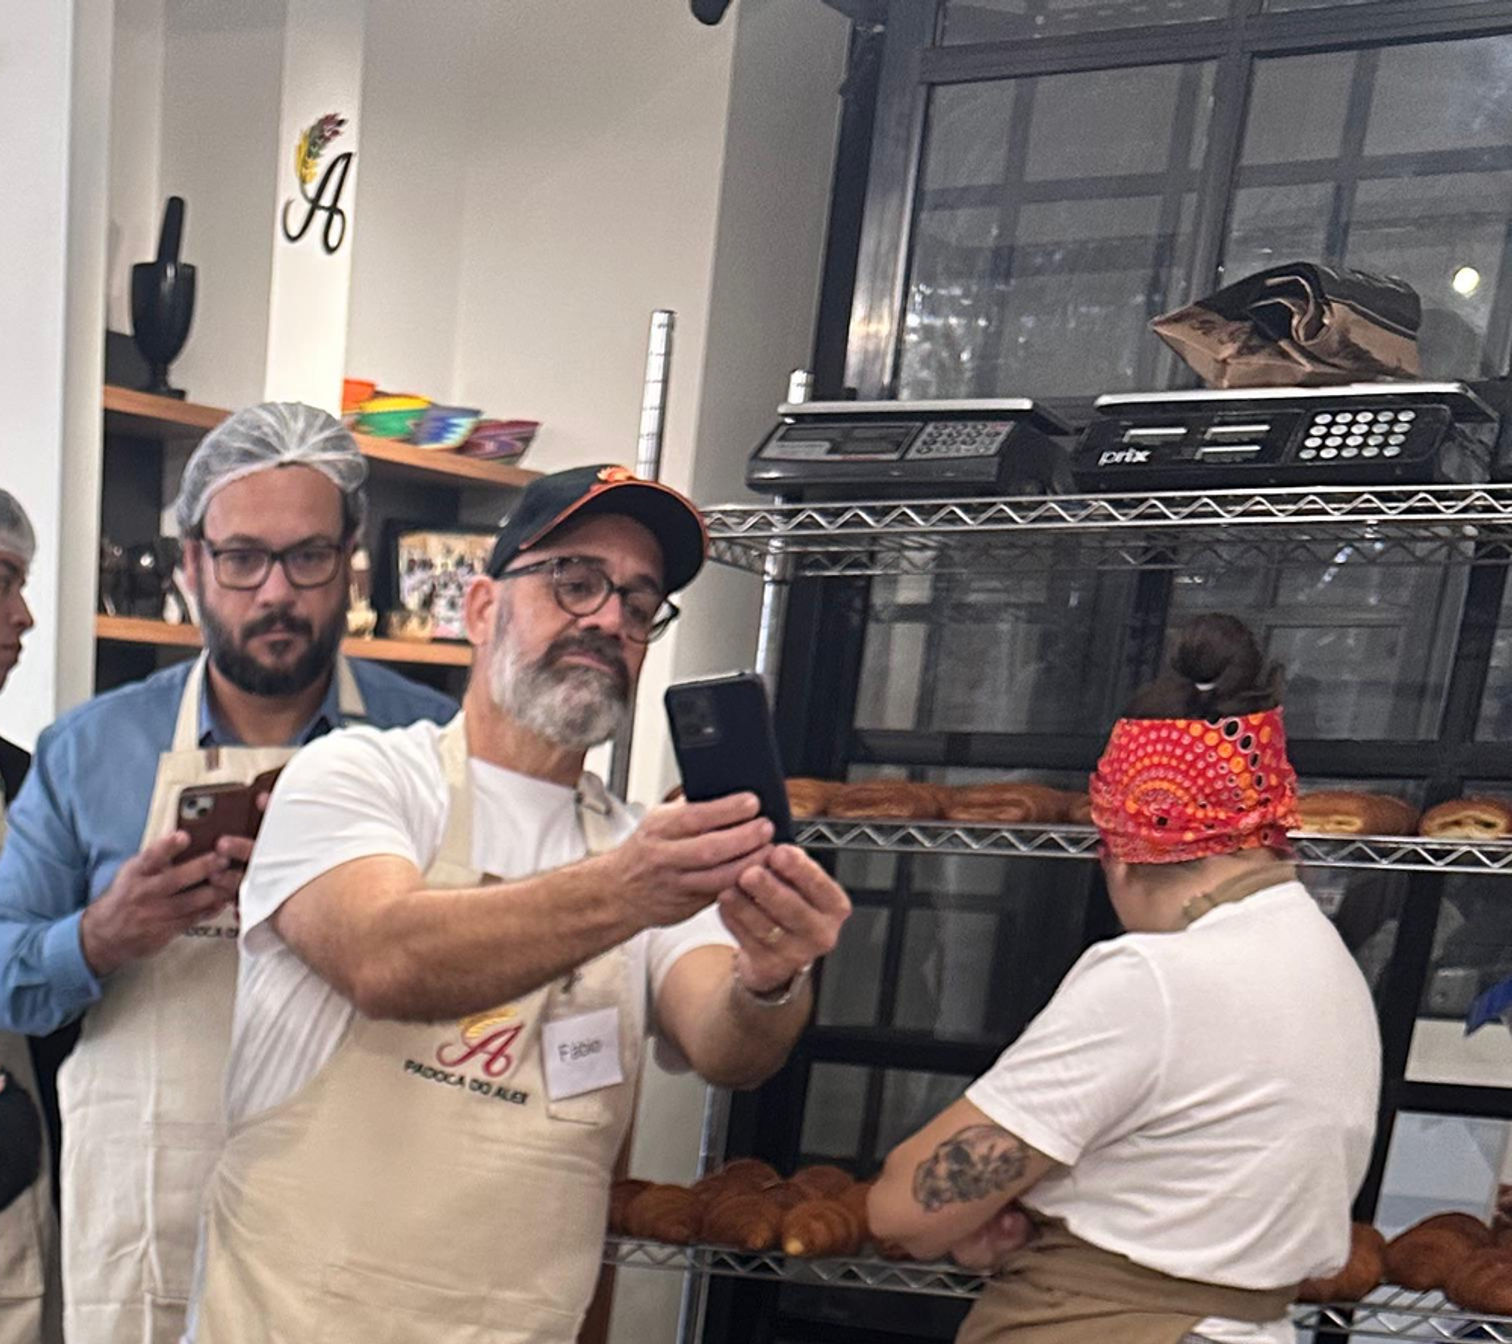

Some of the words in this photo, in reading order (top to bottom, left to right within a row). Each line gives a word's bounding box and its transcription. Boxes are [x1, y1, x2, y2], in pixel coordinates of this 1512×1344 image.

[282, 152, 354, 255] A
[1097, 447, 1153, 467] prix
[436, 1021, 525, 1078] A
[404, 1058, 465, 1088] PADOCA
[468, 1078, 492, 1096] DO
[492, 1086, 529, 1106] ALEX
